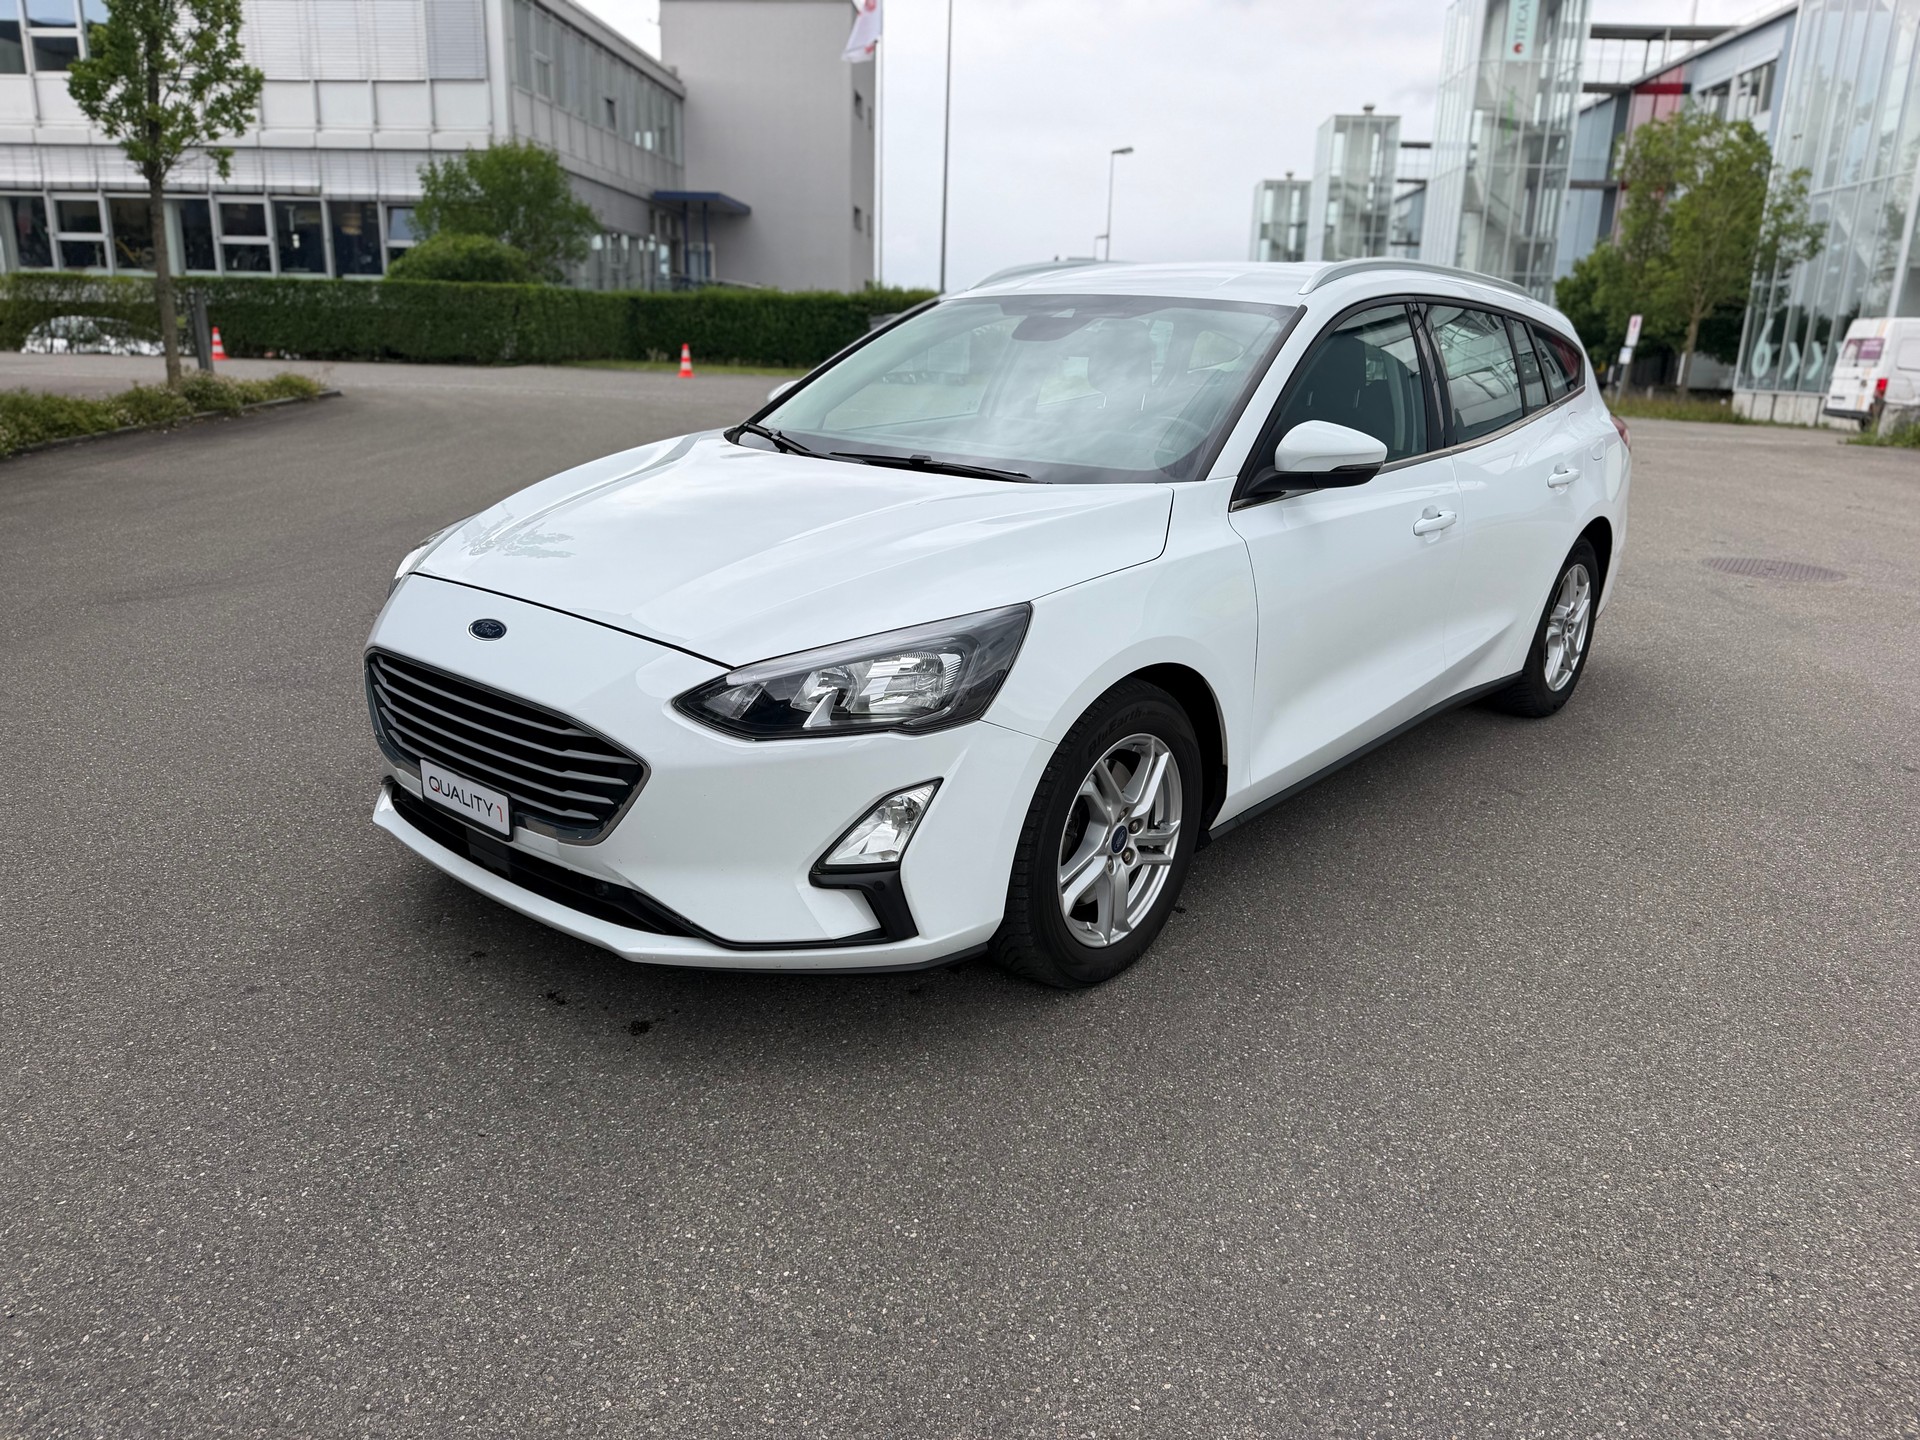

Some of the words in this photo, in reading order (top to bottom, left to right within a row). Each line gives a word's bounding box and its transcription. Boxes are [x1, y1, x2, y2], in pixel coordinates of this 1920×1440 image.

[1752, 319, 1774, 378] 6
[428, 776, 494, 817] QUALITY
[496, 805, 503, 822] 1
